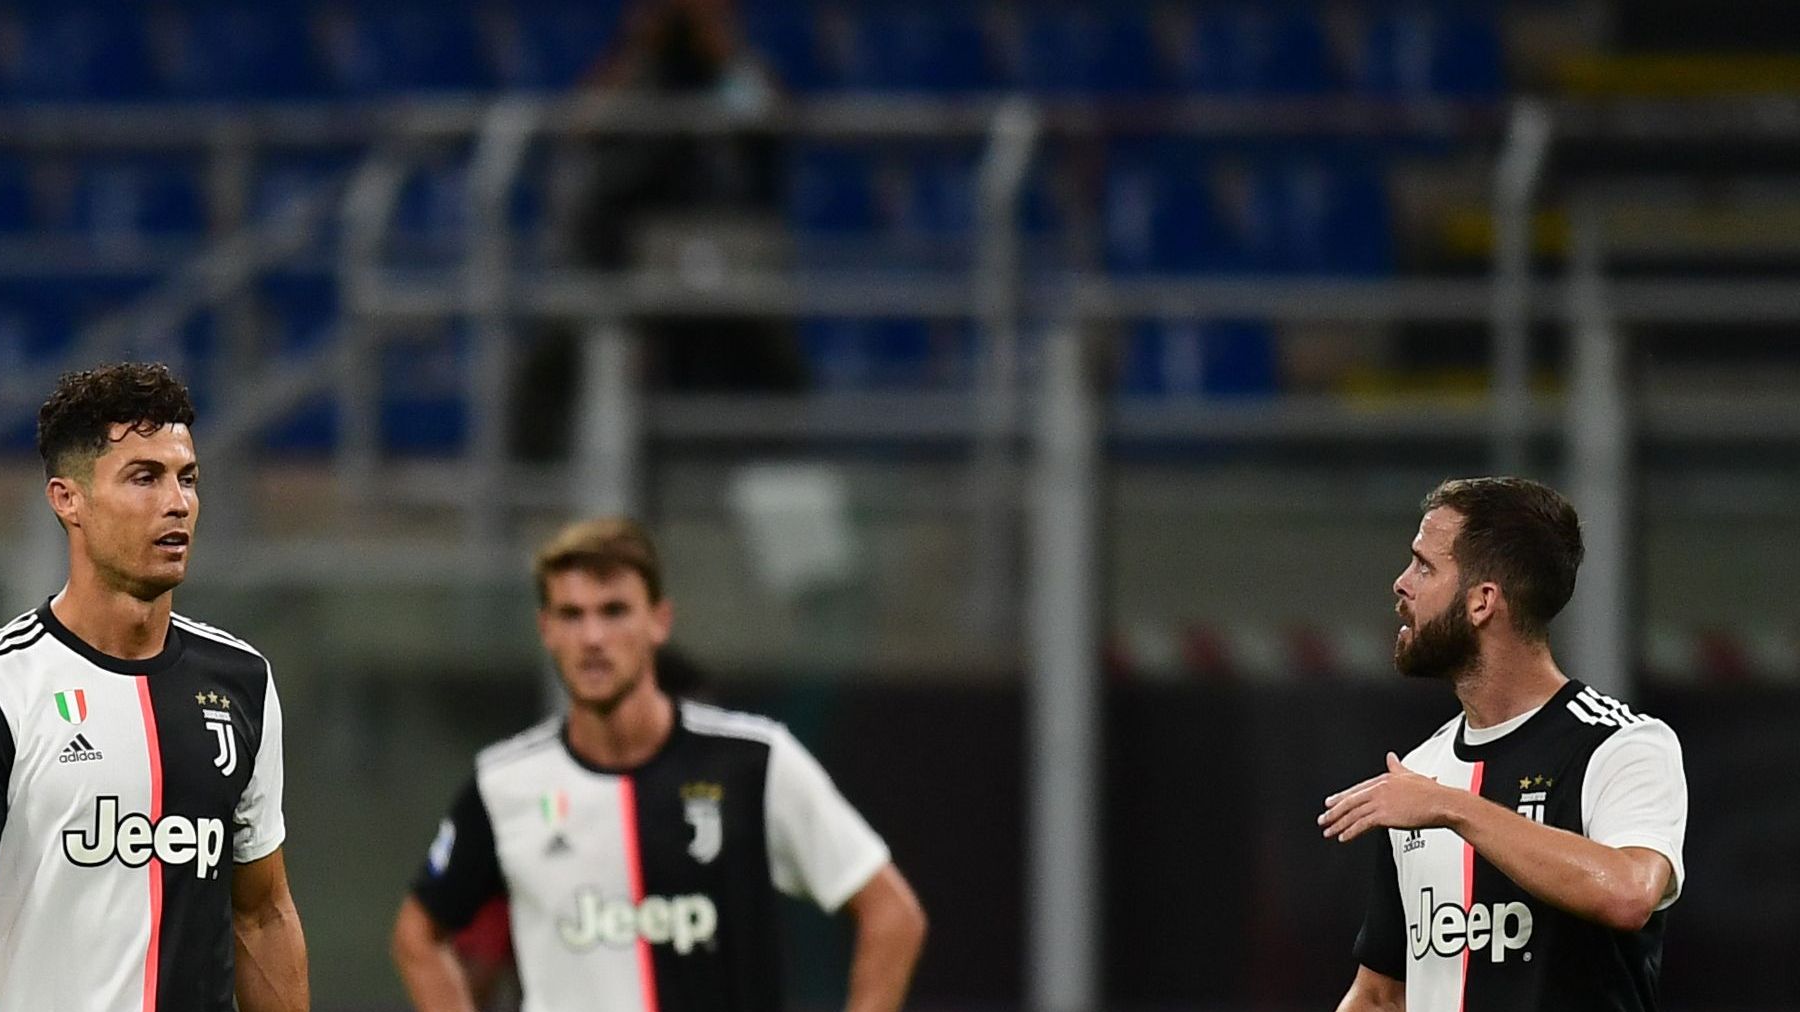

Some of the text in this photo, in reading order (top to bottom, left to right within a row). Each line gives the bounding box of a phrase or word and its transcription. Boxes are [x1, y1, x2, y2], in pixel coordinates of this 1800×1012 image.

[59, 750, 103, 764] adidas
[62, 796, 225, 879] Jeep
[557, 887, 718, 956] Jeep
[1409, 887, 1533, 963] Jeep
